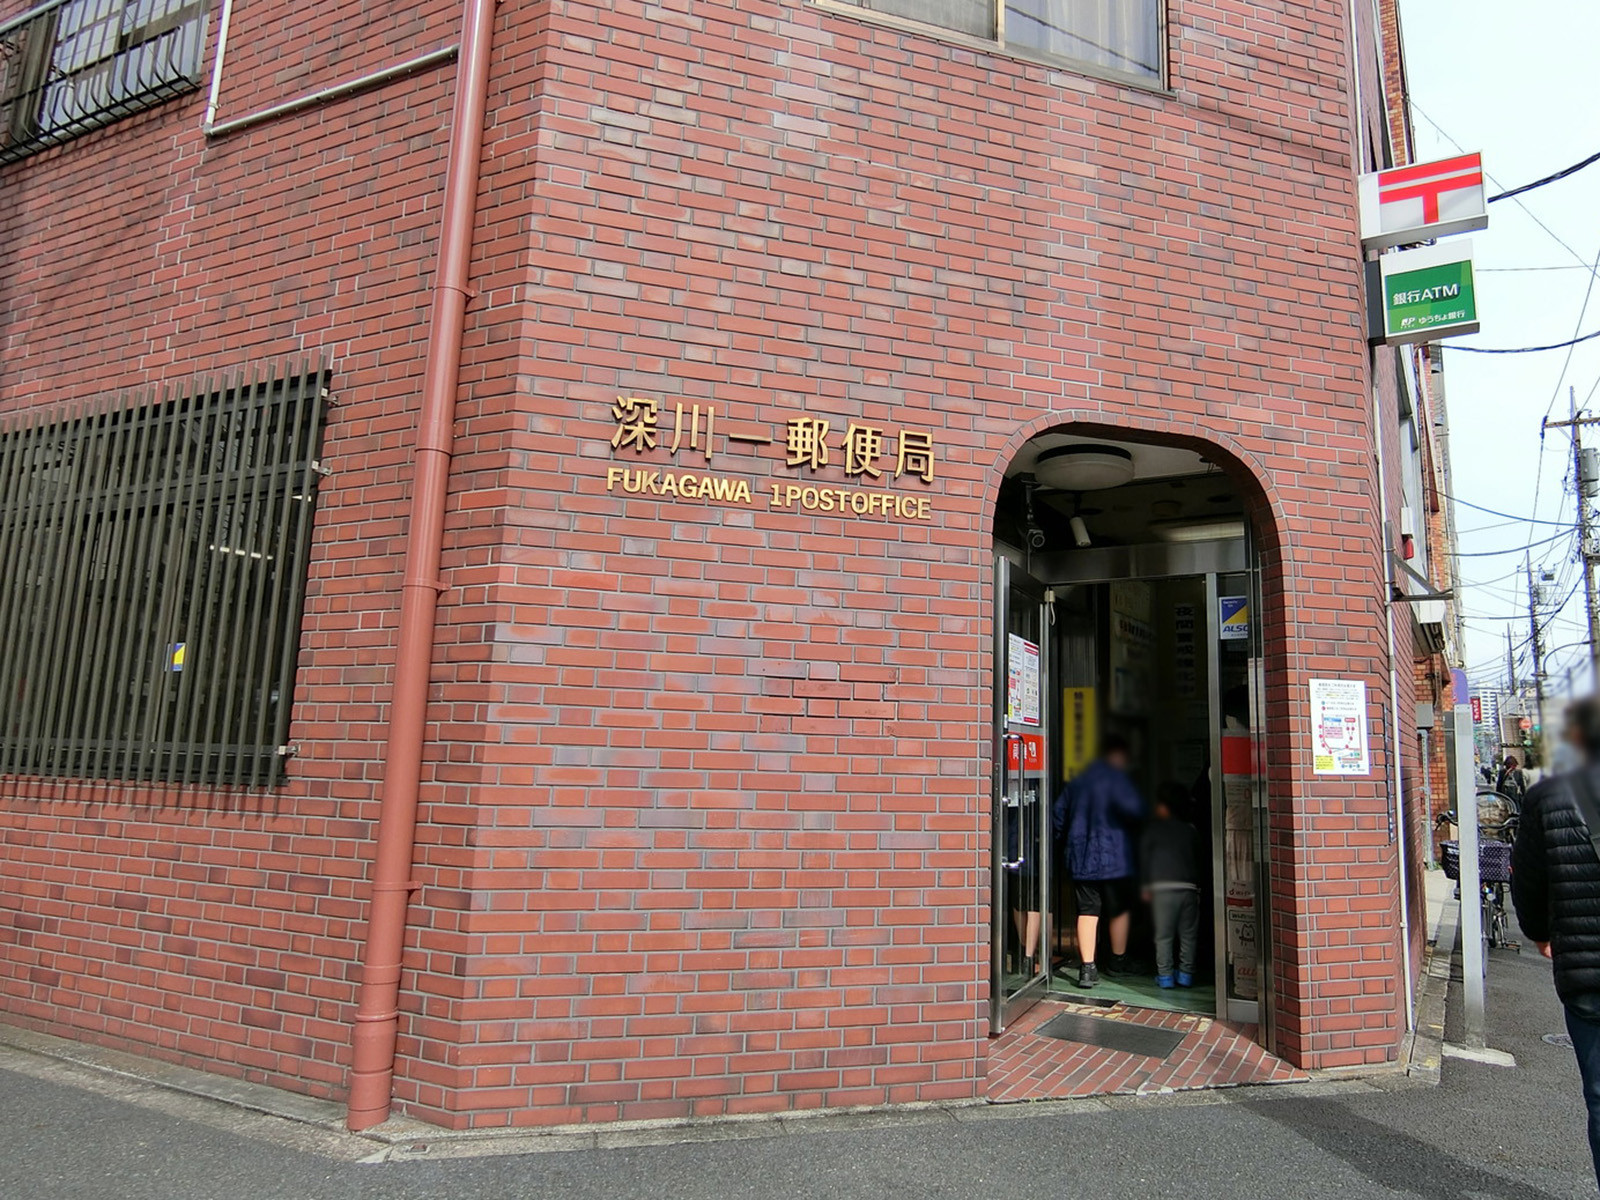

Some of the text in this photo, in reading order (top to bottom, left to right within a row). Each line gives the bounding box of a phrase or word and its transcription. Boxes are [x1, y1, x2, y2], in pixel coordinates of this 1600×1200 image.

[1393, 283, 1458, 306] 銀行ATM
[1418, 310, 1466, 324] ゆうちょ銀行
[610, 395, 935, 482] 深川一郵便局
[606, 467, 752, 504] FUKAGAWA
